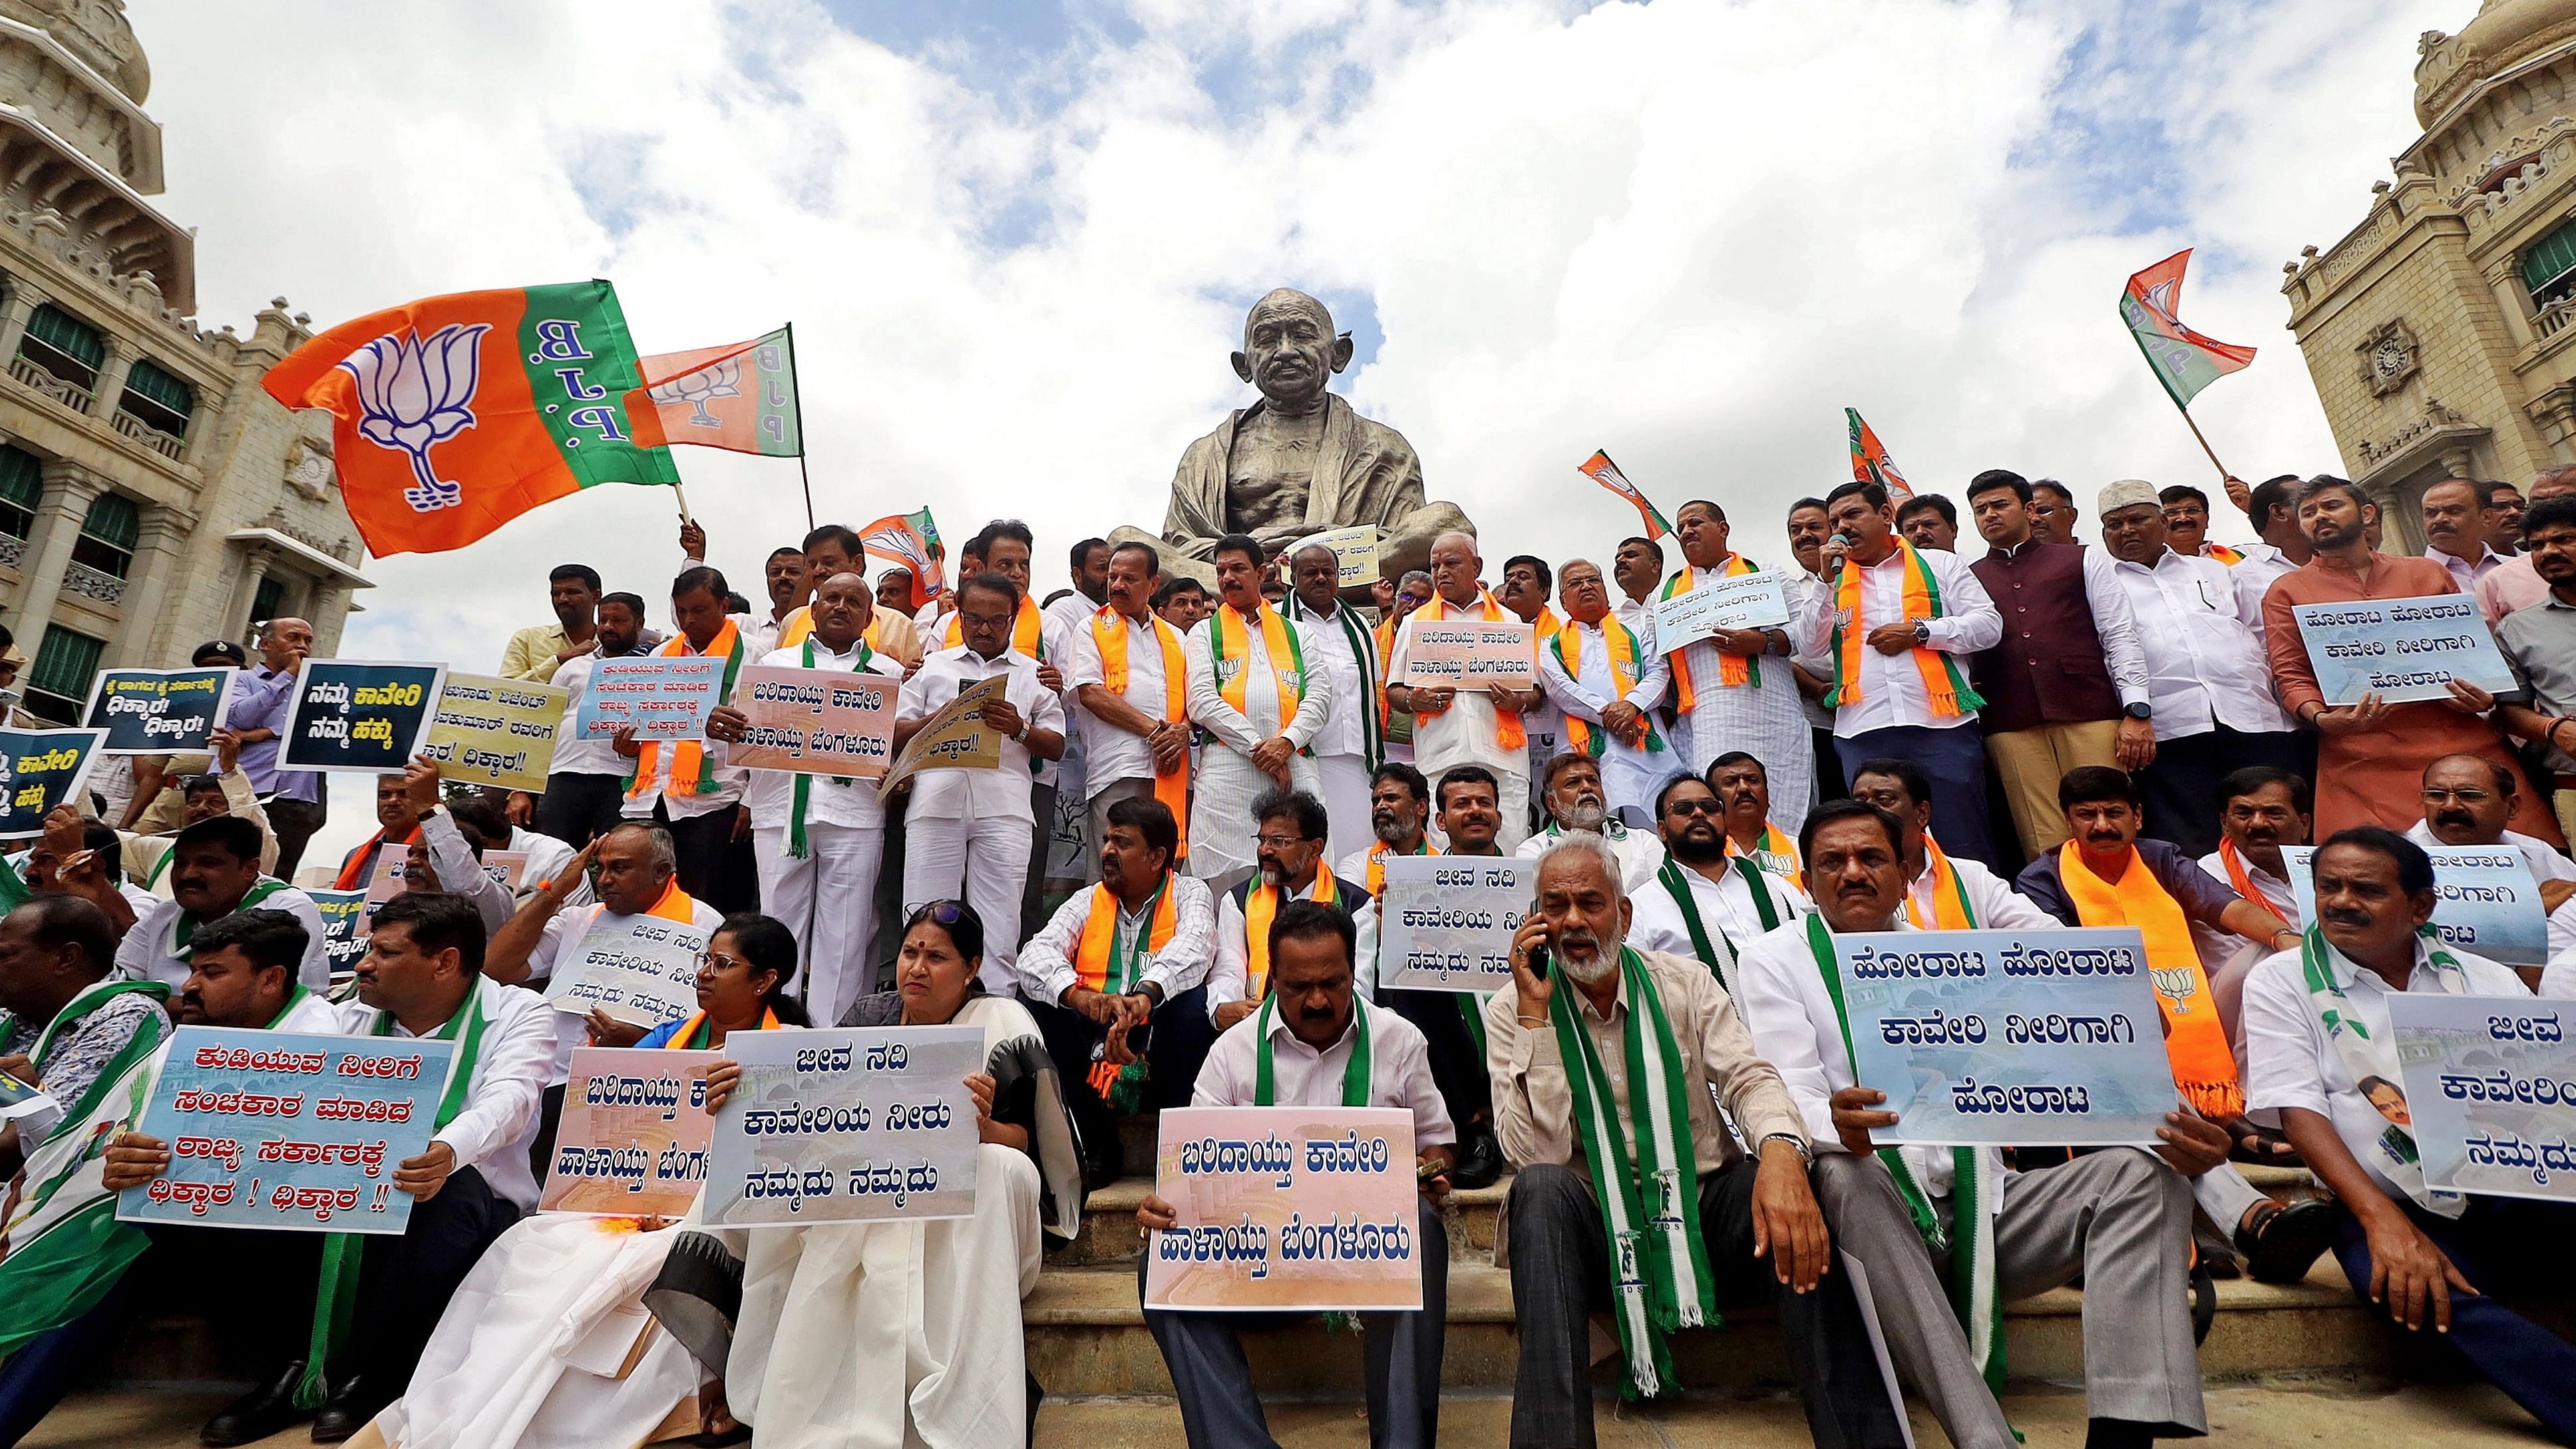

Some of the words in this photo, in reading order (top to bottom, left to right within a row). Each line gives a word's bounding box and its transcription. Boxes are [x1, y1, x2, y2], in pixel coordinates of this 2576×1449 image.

[1339, 562, 1364, 580] ಕ್ಕಾರ!!
[2304, 606, 2384, 629] ಹೋರಾಟ
[2391, 600, 2472, 623] ಹೋರಾಟ
[1422, 629, 1477, 649] ಬರಿದಾಯ್ತು
[1481, 629, 1522, 644] ಕಾವೇರಿ
[2324, 638, 2387, 658] ಕಾವೇರಿ
[2396, 634, 2478, 656] ನೀರಿಗಾಗಿ
[1411, 658, 1462, 680] ಹಾಳಾಯ್ತು
[1468, 657, 1529, 673] ಬೆಂಗಳೂರು
[2369, 667, 2452, 690] ಹೋರಾಟ
[106, 696, 170, 720] ಧಿಕ್ಕಾರ!
[308, 682, 351, 713] ನಮ್ಮ
[353, 682, 422, 706] ಕಾವೇರಿ
[754, 680, 825, 714] ಬರಿದಾಯ್ತು
[832, 685, 882, 711] ಕಾವೇರಿ
[144, 716, 205, 739] ಧಿಕ್ಕಾರ!
[308, 717, 350, 748] ನಮ್ಮ
[352, 718, 394, 750] ಹಕ್ಕು
[510, 722, 554, 740] ರವರಿಗೆ
[811, 726, 886, 757] ಬೆಂಗಳೂರು
[16, 748, 79, 773] ಕಾವೇರಿ
[15, 783, 46, 813] ಹಕ್ಕು
[1435, 864, 1475, 887] ಜೀವ
[1485, 865, 1517, 888] ನದಿ
[1402, 906, 1493, 929] ಕಾವೇರಿಯ
[632, 924, 671, 942] ಜೀವ
[673, 933, 703, 952] ನದಿ
[586, 950, 665, 976] ಕಾವೇರಿಯ
[1407, 947, 1470, 982] ನಮ್ಮದು
[1851, 944, 1986, 980] ಹೋರಾಟ
[2000, 940, 2136, 978] ಹೋರಾಟ
[568, 981, 625, 1008] ನಮ್ಮದು
[629, 992, 689, 1022] ನಮ್ಮದು
[1880, 1008, 1988, 1046] ಕಾವೇರಿ
[2005, 1010, 2135, 1045] ನೀರಿಗಾಗಿ
[2487, 1008, 2564, 1043] ಜೀವ
[195, 1044, 327, 1077] ಕುಡಿಯುವ
[337, 1052, 423, 1081] ನೀರಿಗೆ
[795, 1039, 855, 1074] ಜೀವ
[865, 1040, 910, 1071] ನದಿ
[173, 1087, 304, 1118] ಸಂಚಕಾರ
[315, 1096, 413, 1124] ಮಾಡಿದ
[586, 1069, 681, 1121] ಬರಿದಾಯ್ತು
[1951, 1077, 2090, 1115] ಹೋರಾಟ
[743, 1100, 872, 1136] ಕಾವೇರಿಯ
[884, 1096, 951, 1132] ನೀರು
[174, 1134, 244, 1171] ರಾಜ್ಯ
[258, 1138, 389, 1177] ಸರ್ಕಾರಕ್ಕೆ
[557, 1139, 649, 1194] ಹಾಳಾಯ್ತು
[1181, 1129, 1294, 1189] ಬರಿದಾಯ್ತು
[1306, 1129, 1389, 1175] ಕಾವೇರಿ
[147, 1177, 236, 1216] ಧಿಕ್ಕಾರ
[271, 1181, 361, 1221] ಧಿಕ್ಕಾರ
[744, 1161, 836, 1213] ನಮ್ಮದು
[848, 1158, 940, 1209] ನಮ್ಮದು
[1159, 1211, 1269, 1281] ಹಾಳಾಯ್ತು
[1280, 1211, 1411, 1262] ಬೆಂಗಳೂರು
